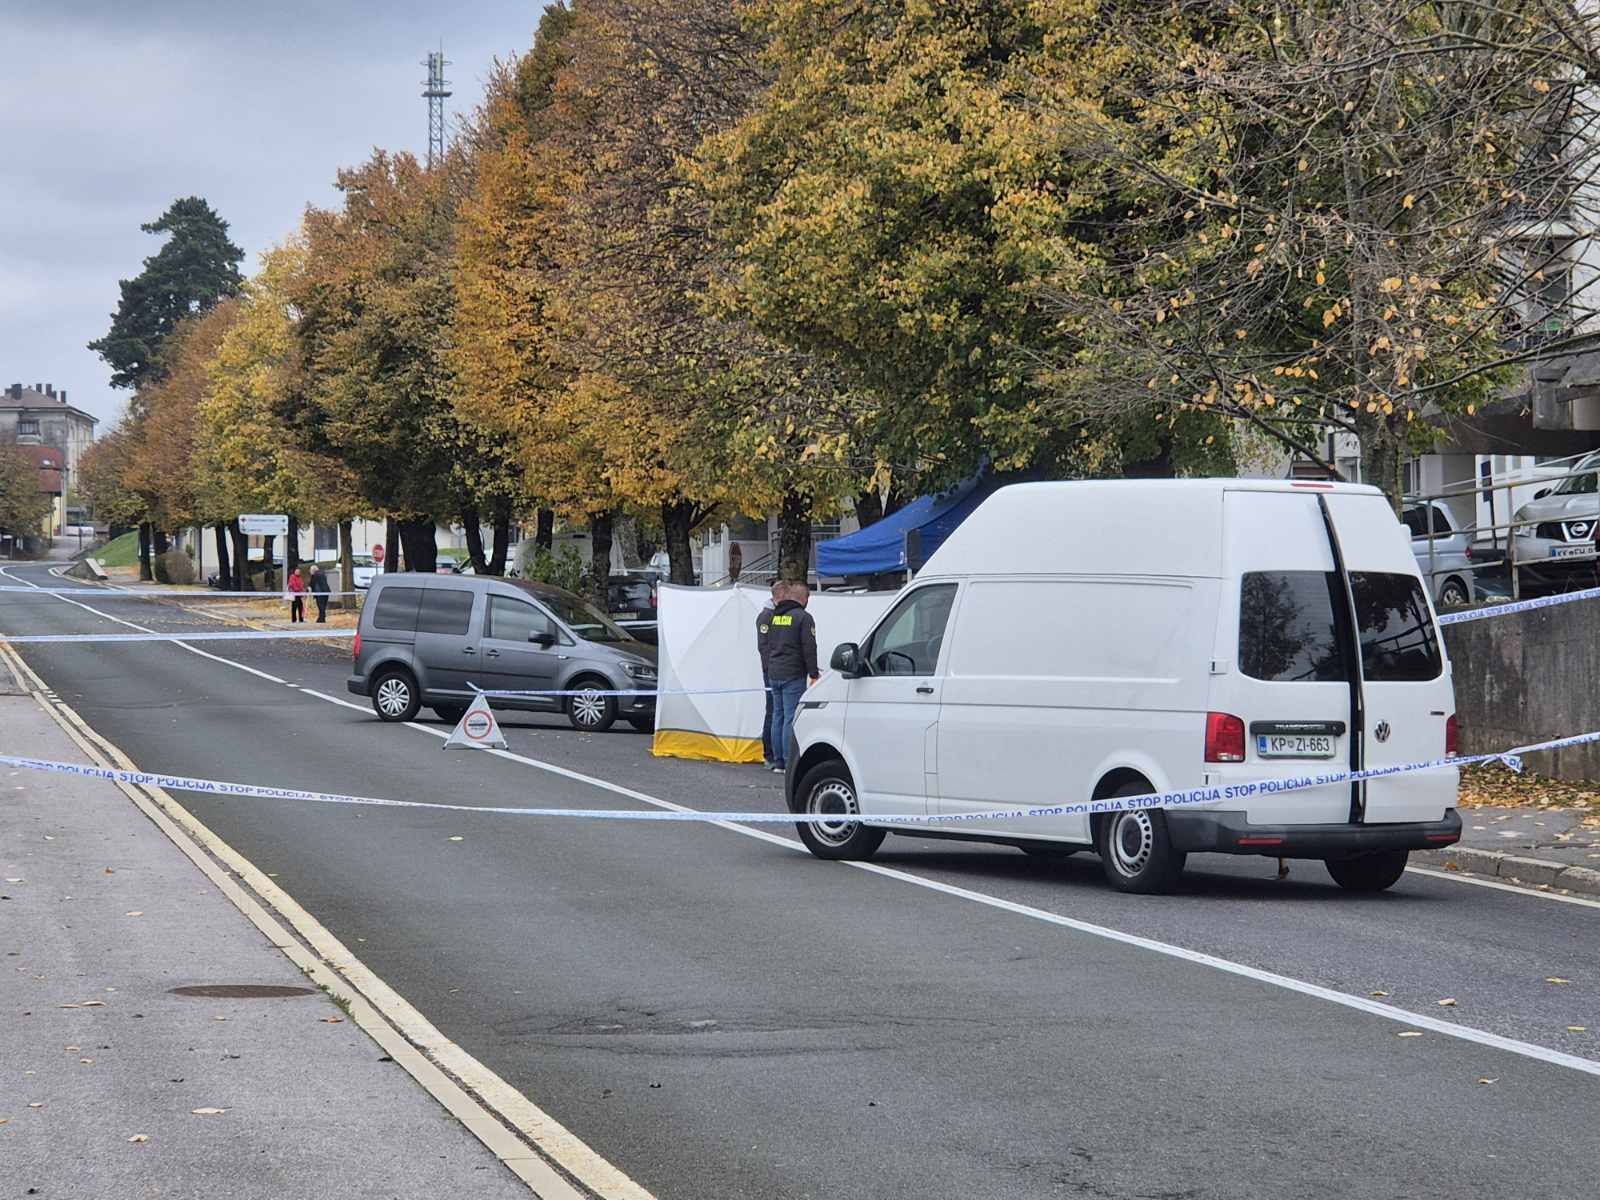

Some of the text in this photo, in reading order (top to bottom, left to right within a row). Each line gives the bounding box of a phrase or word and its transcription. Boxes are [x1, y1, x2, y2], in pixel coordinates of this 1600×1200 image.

[1271, 737, 1329, 751] KP ZI-663
[120, 772, 153, 785] STOP
[157, 778, 215, 791] POLICIJA
[220, 784, 254, 794] STOP
[256, 788, 314, 800] POLICIJA
[1066, 801, 1123, 815] POLICIJA
[1127, 796, 1161, 809] STOP
[1165, 788, 1221, 805] POLICIJA
[1225, 784, 1257, 799] STOP
[1260, 776, 1312, 793] POLICIJA
